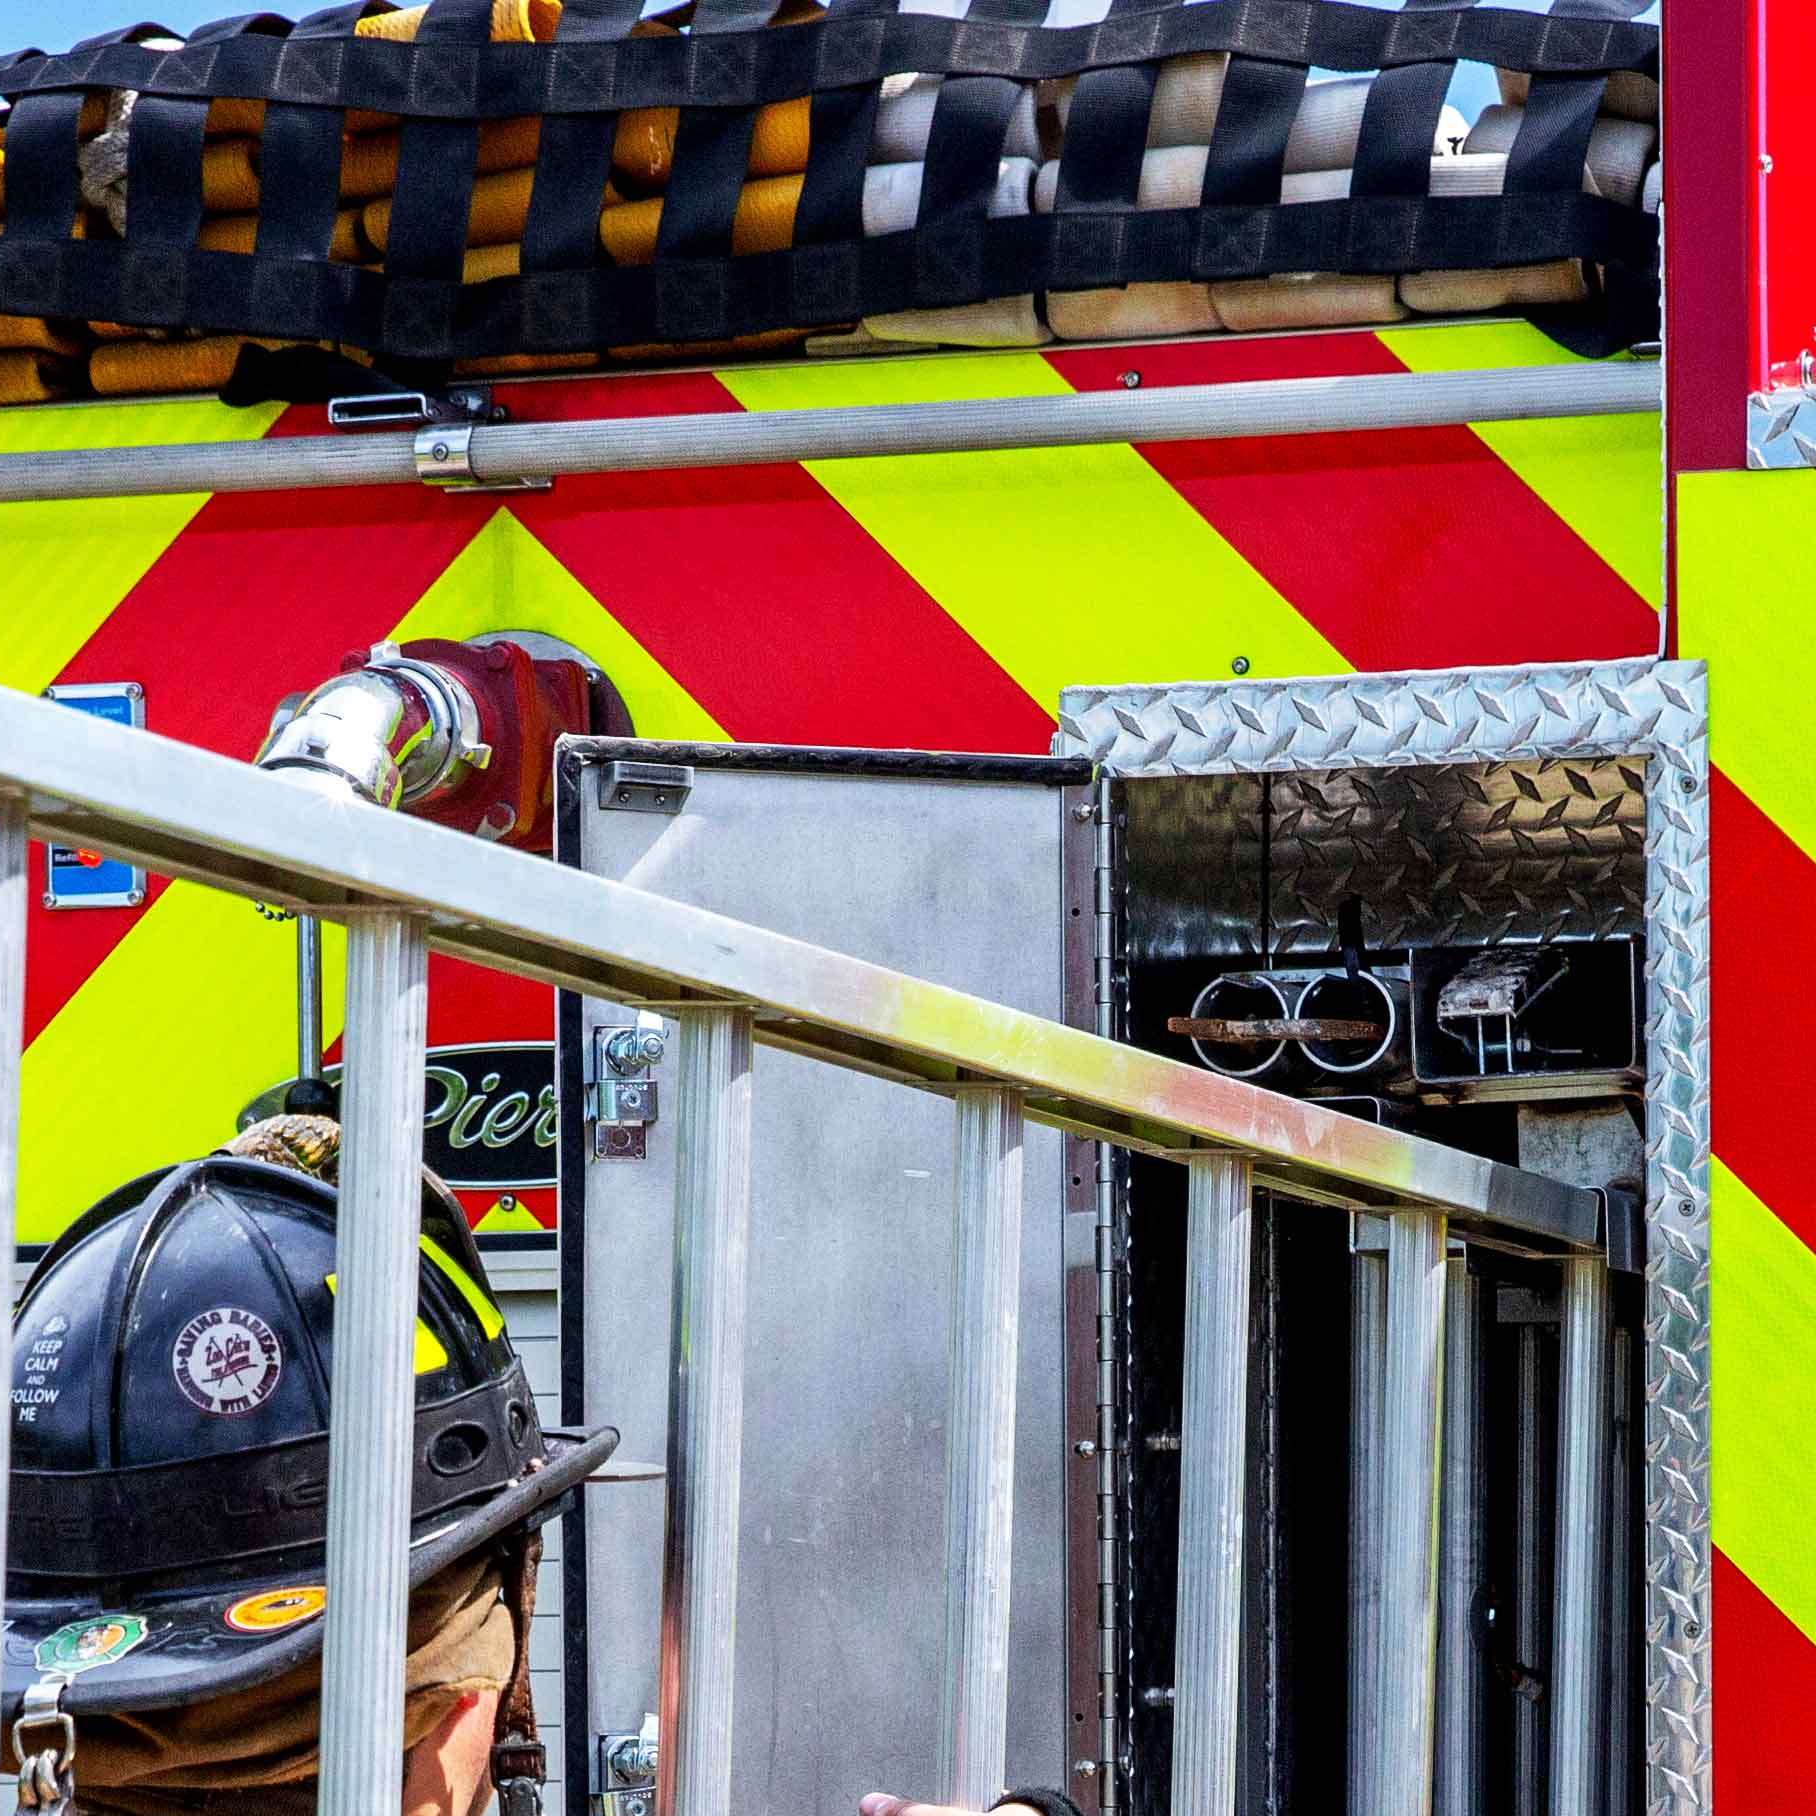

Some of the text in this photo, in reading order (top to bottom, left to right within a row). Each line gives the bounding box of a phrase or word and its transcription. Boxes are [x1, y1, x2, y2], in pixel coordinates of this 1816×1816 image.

[32, 1339, 64, 1355] KEEP
[24, 1357, 59, 1372] CALM
[26, 1375, 46, 1386] AND
[19, 1406, 38, 1422] ME
